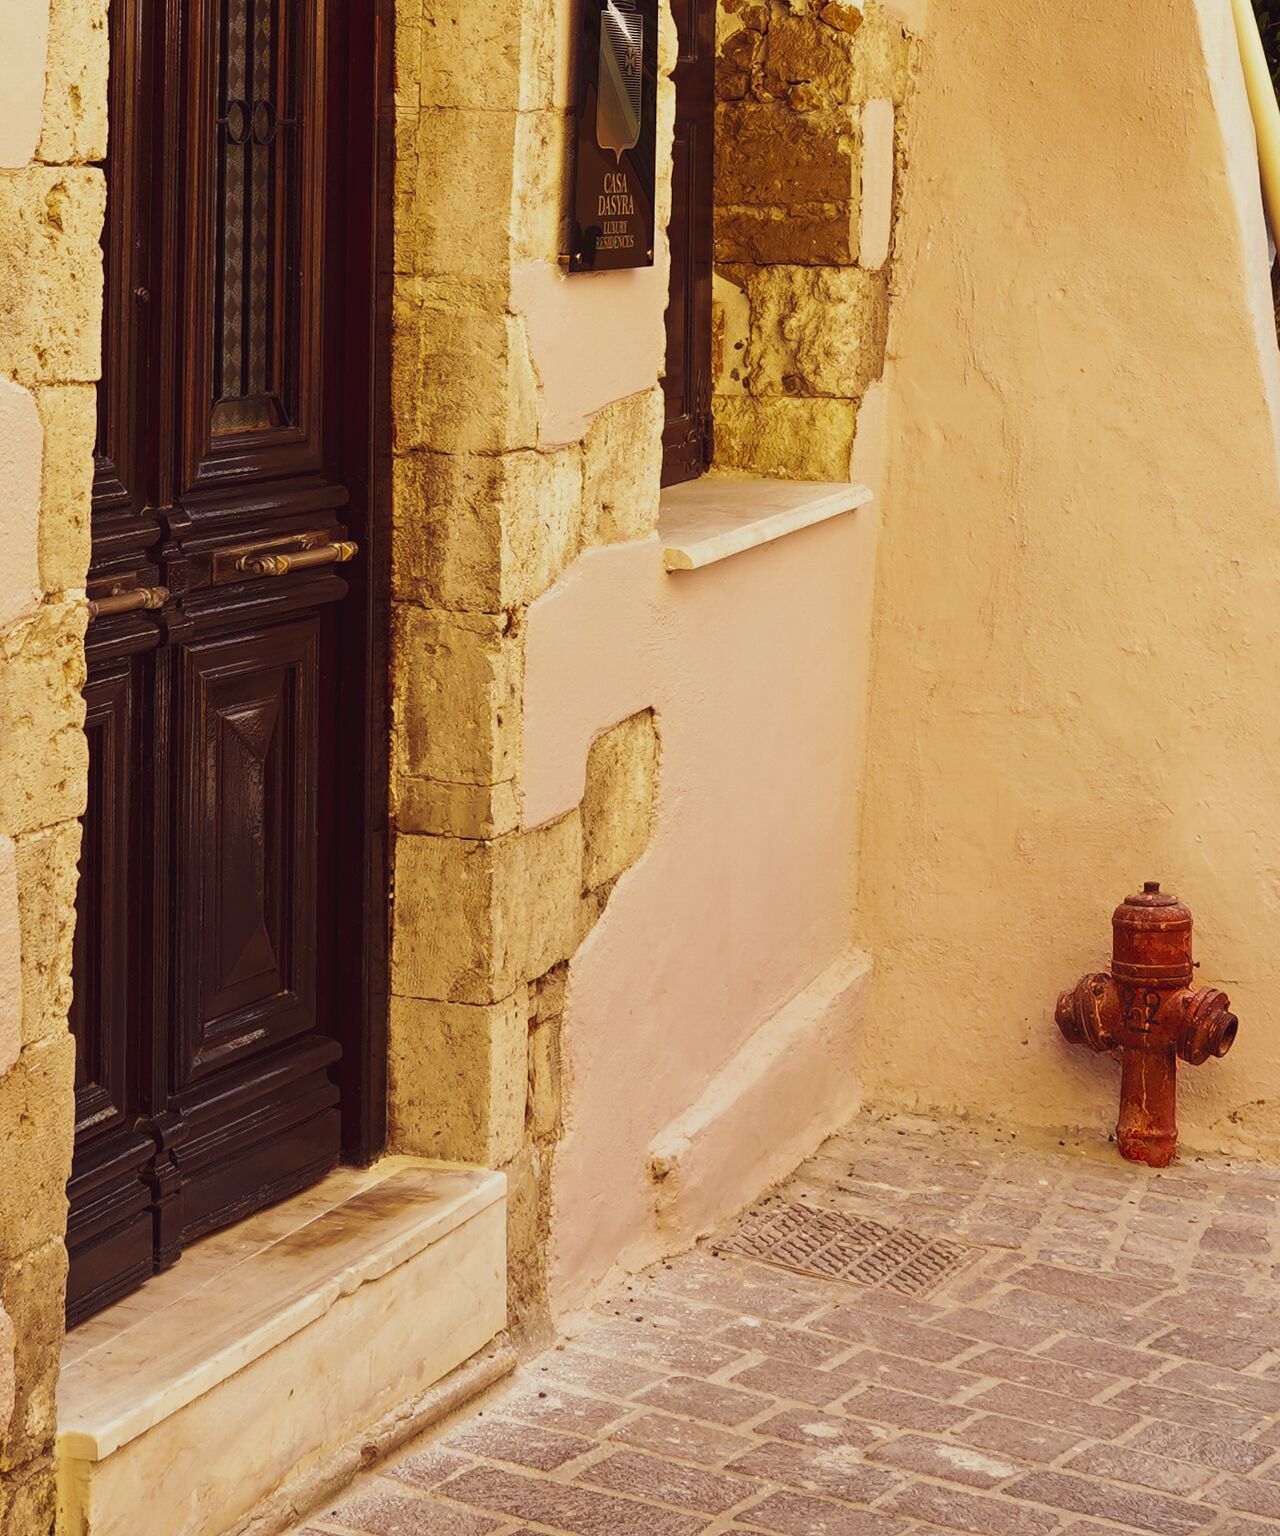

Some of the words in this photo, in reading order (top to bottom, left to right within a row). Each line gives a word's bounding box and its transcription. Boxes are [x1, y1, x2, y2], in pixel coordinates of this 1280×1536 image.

[603, 173, 628, 194] CASA
[598, 194, 635, 216] DASYRA
[603, 220, 628, 235] LUXURY
[595, 235, 635, 250] RESIDENCES
